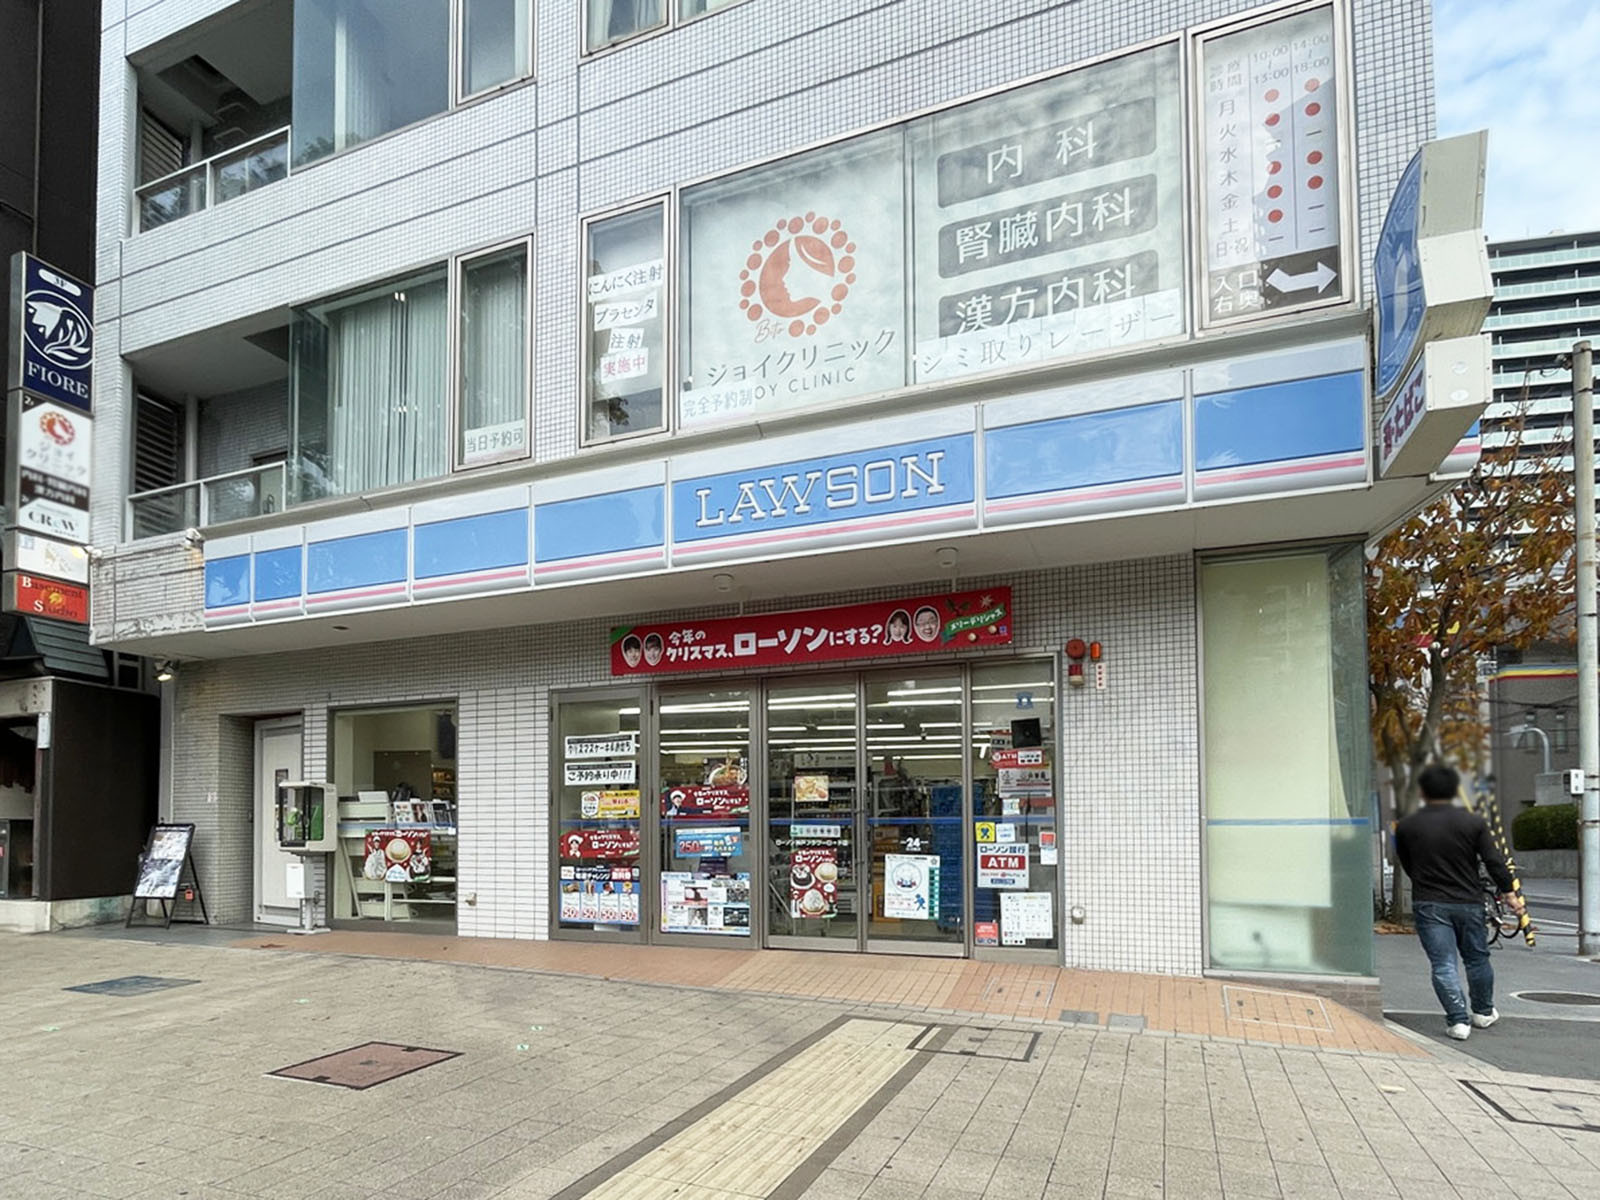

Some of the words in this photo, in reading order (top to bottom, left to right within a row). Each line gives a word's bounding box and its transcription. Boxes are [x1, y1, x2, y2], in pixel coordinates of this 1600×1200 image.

[1218, 99, 1236, 117] 月
[1218, 122, 1237, 140] 火
[986, 121, 1098, 184] 内科
[1219, 146, 1238, 164] 水
[1219, 169, 1239, 187] 木
[1221, 192, 1240, 211] 金
[955, 187, 1135, 264] 腎臓内科
[1222, 217, 1240, 234] 土
[588, 265, 663, 295] にんにく注射
[1213, 269, 1258, 293] 入口
[596, 299, 654, 324] プラセンタ
[956, 263, 1136, 335] 漢方内科
[610, 333, 641, 349] 注射
[923, 310, 1175, 374] シミ取りレーザー
[603, 355, 646, 378] 実施中
[707, 328, 896, 387] ジョイクリニック
[27, 361, 88, 398] FIORE
[788, 367, 856, 394] CLINIC
[683, 388, 753, 418] 完全予約制
[466, 428, 523, 453] 当日予約可
[695, 450, 946, 528] LAWSON
[668, 629, 706, 647] 今年の
[988, 857, 1019, 868] ATM
